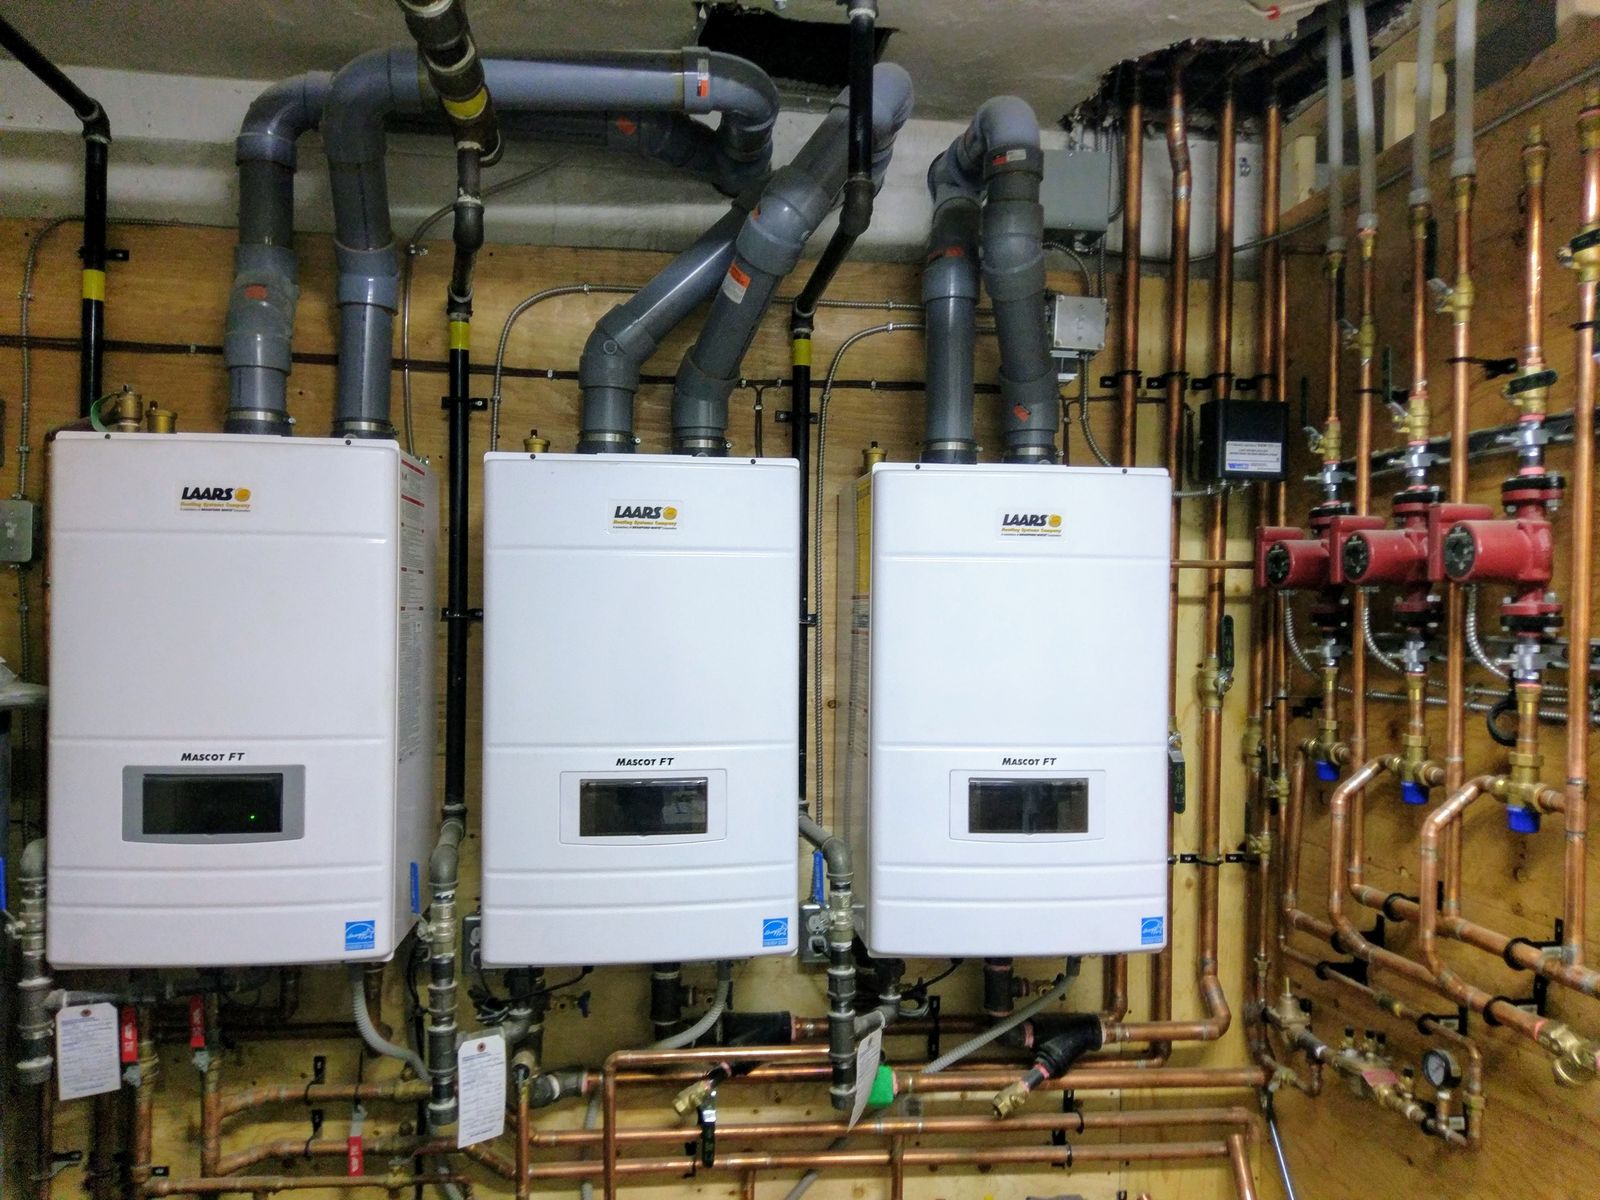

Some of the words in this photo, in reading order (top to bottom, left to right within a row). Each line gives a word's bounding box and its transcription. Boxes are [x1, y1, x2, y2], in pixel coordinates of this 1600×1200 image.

[181, 486, 234, 501] LAARS
[614, 505, 663, 519] LAARS
[1002, 513, 1048, 527] LAARS
[228, 752, 246, 761] FT
[659, 757, 675, 766] FT
[1042, 757, 1057, 766] FT
